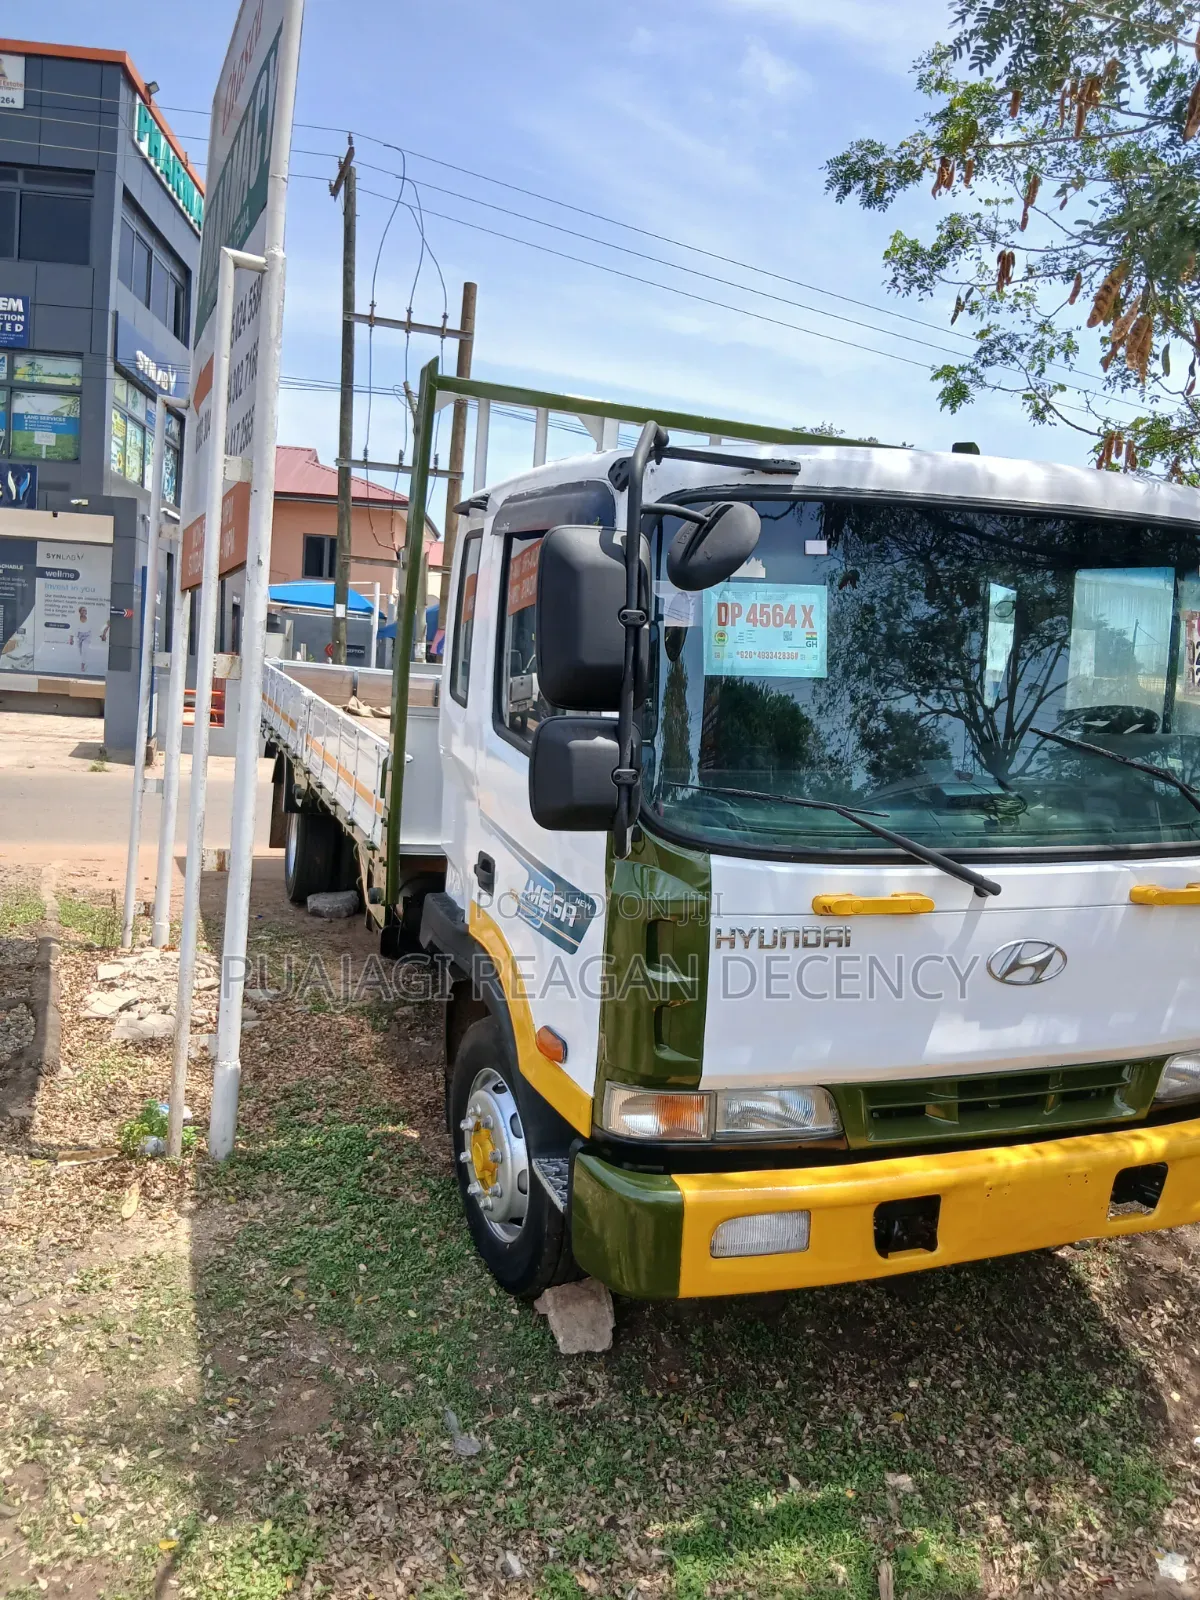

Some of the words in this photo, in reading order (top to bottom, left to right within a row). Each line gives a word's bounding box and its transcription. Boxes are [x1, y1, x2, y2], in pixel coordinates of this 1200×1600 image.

[46, 552, 76, 561] SYNLAB
[44, 582, 69, 591] Invest
[717, 602, 743, 627] DP
[745, 603, 797, 629] 4564
[801, 604, 815, 629] X
[524, 879, 578, 928] MEGA
[574, 896, 592, 912] NEW
[714, 925, 852, 949] HYUNDAI
